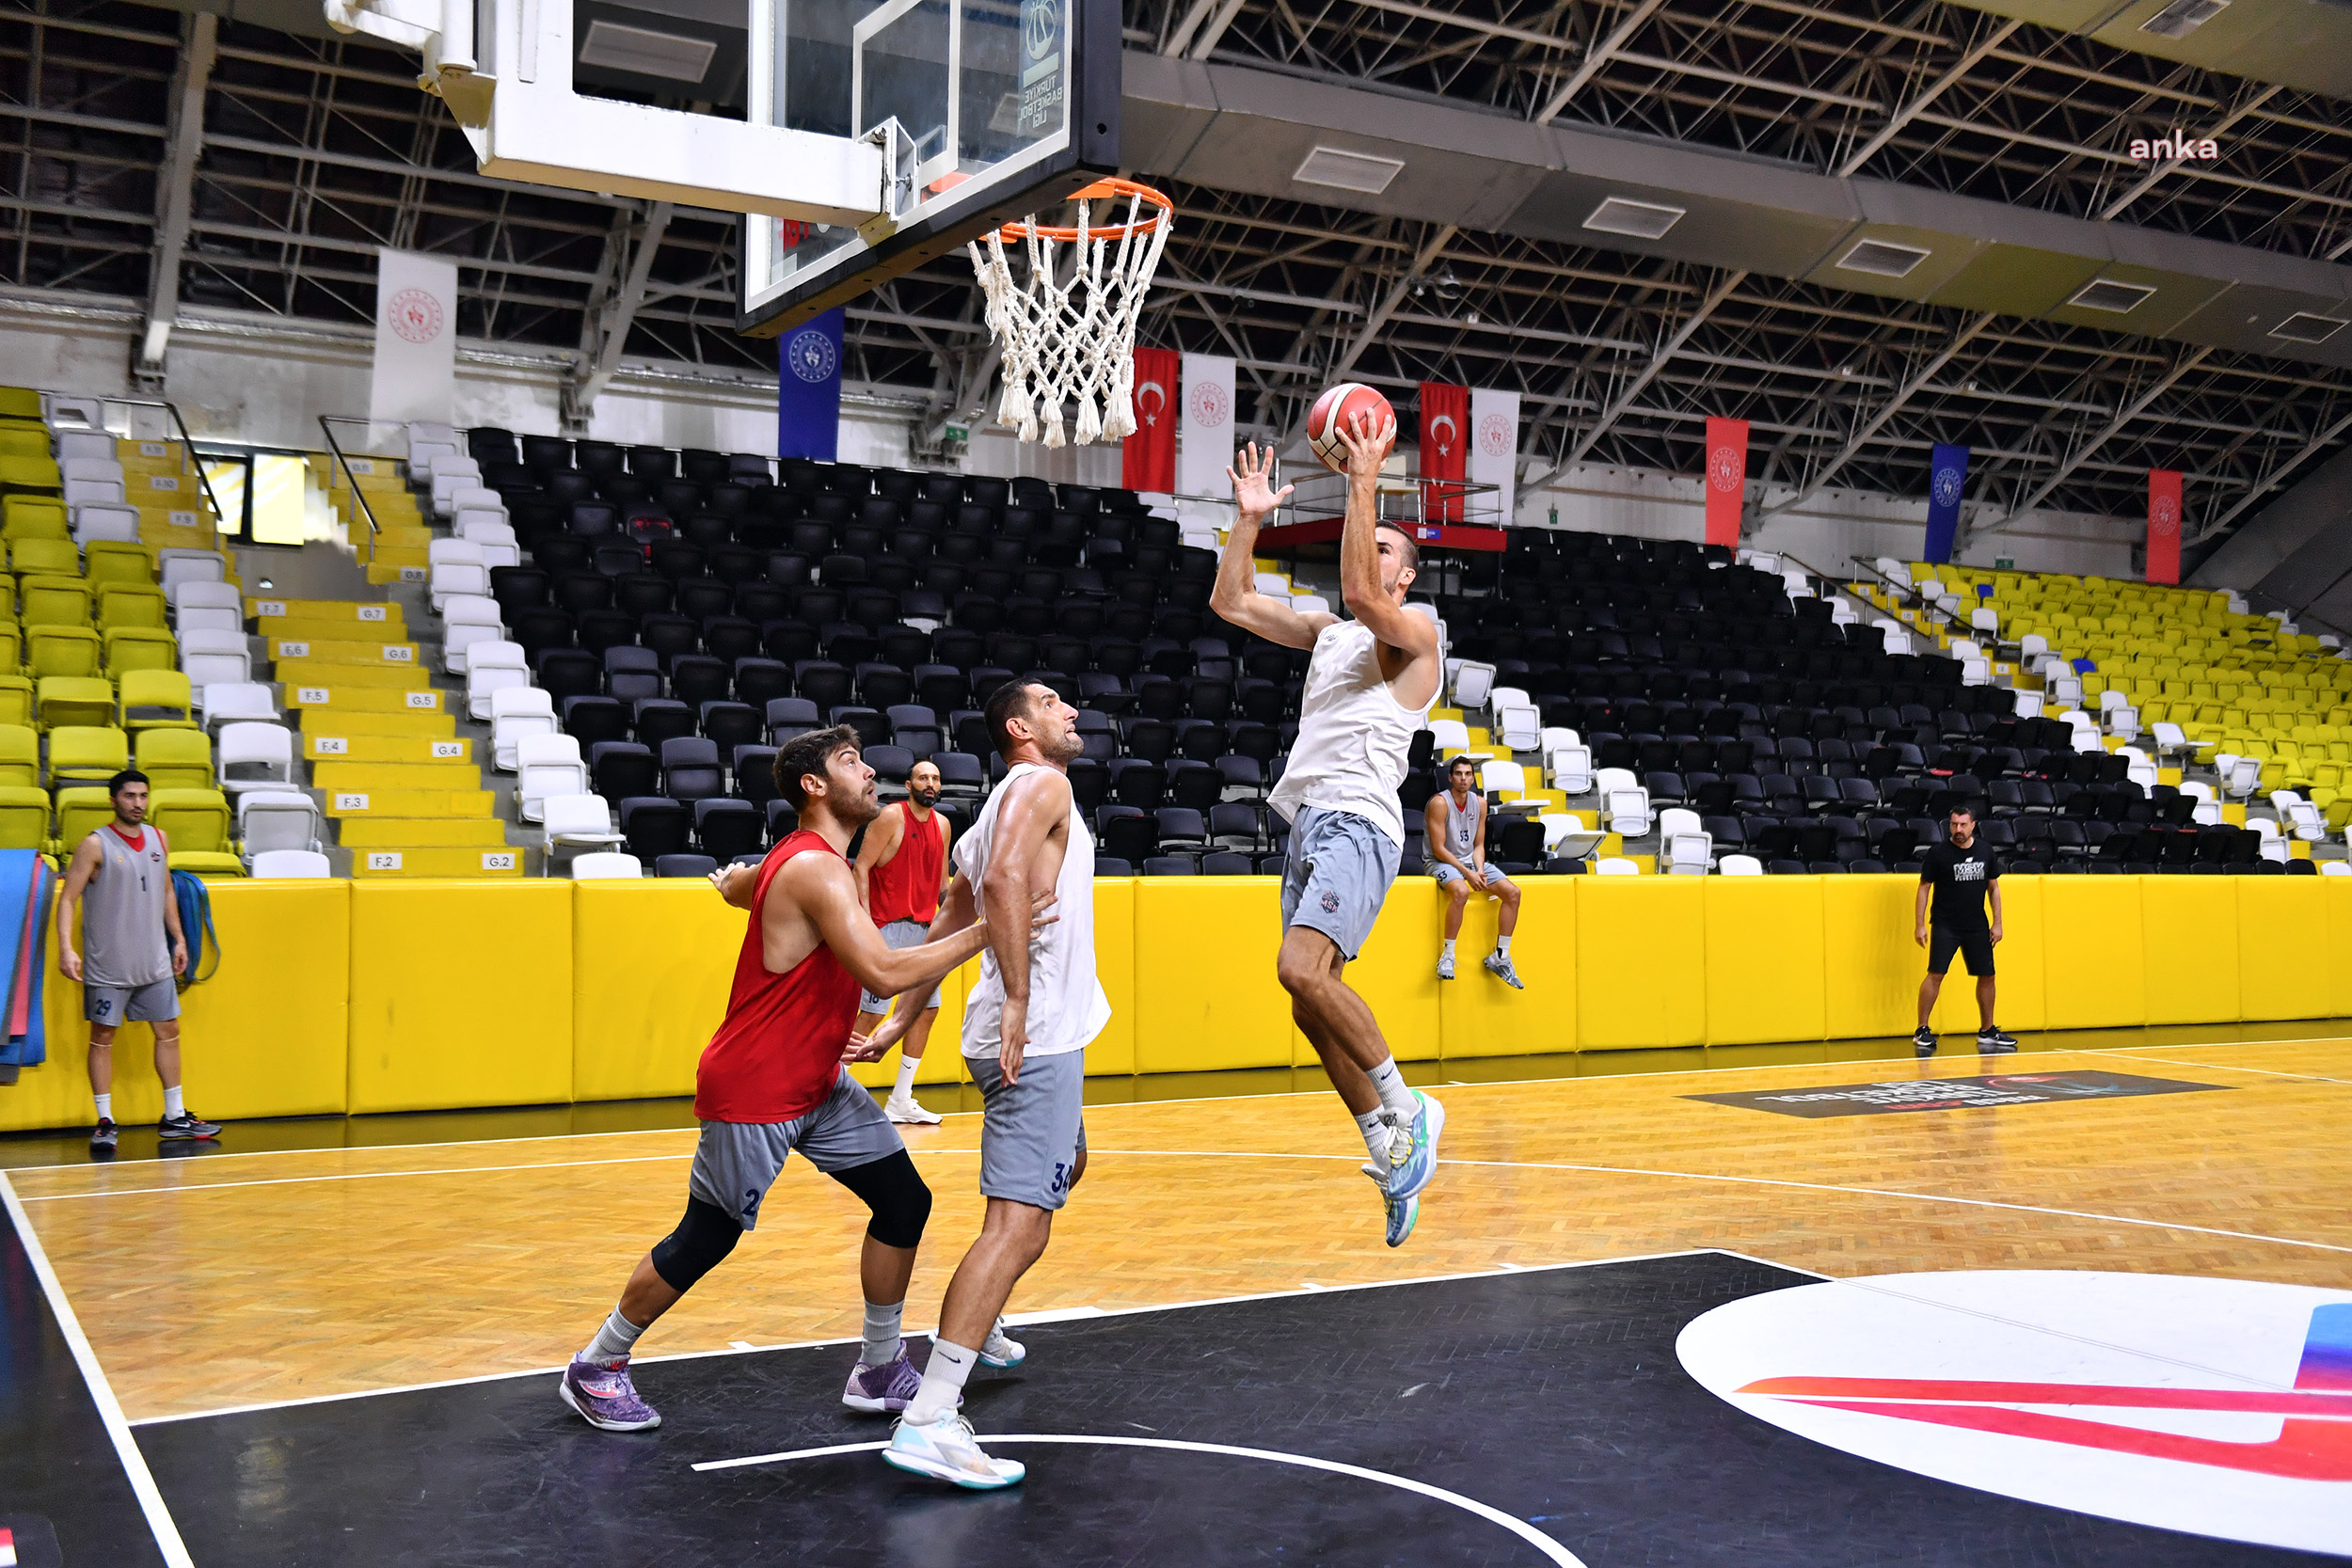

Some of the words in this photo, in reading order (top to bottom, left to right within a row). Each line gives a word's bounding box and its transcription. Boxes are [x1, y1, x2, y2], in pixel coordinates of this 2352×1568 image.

[364, 610, 380, 619] G.7
[389, 650, 407, 658] G.6
[306, 691, 323, 701] F.5
[412, 696, 432, 705] G.5
[322, 741, 339, 751] F.4
[438, 746, 458, 755] G.4
[343, 798, 361, 808] F.3
[375, 857, 393, 867] F.2
[489, 857, 510, 867] G.2
[95, 999, 112, 1017] 29
[741, 1188, 760, 1216] 2
